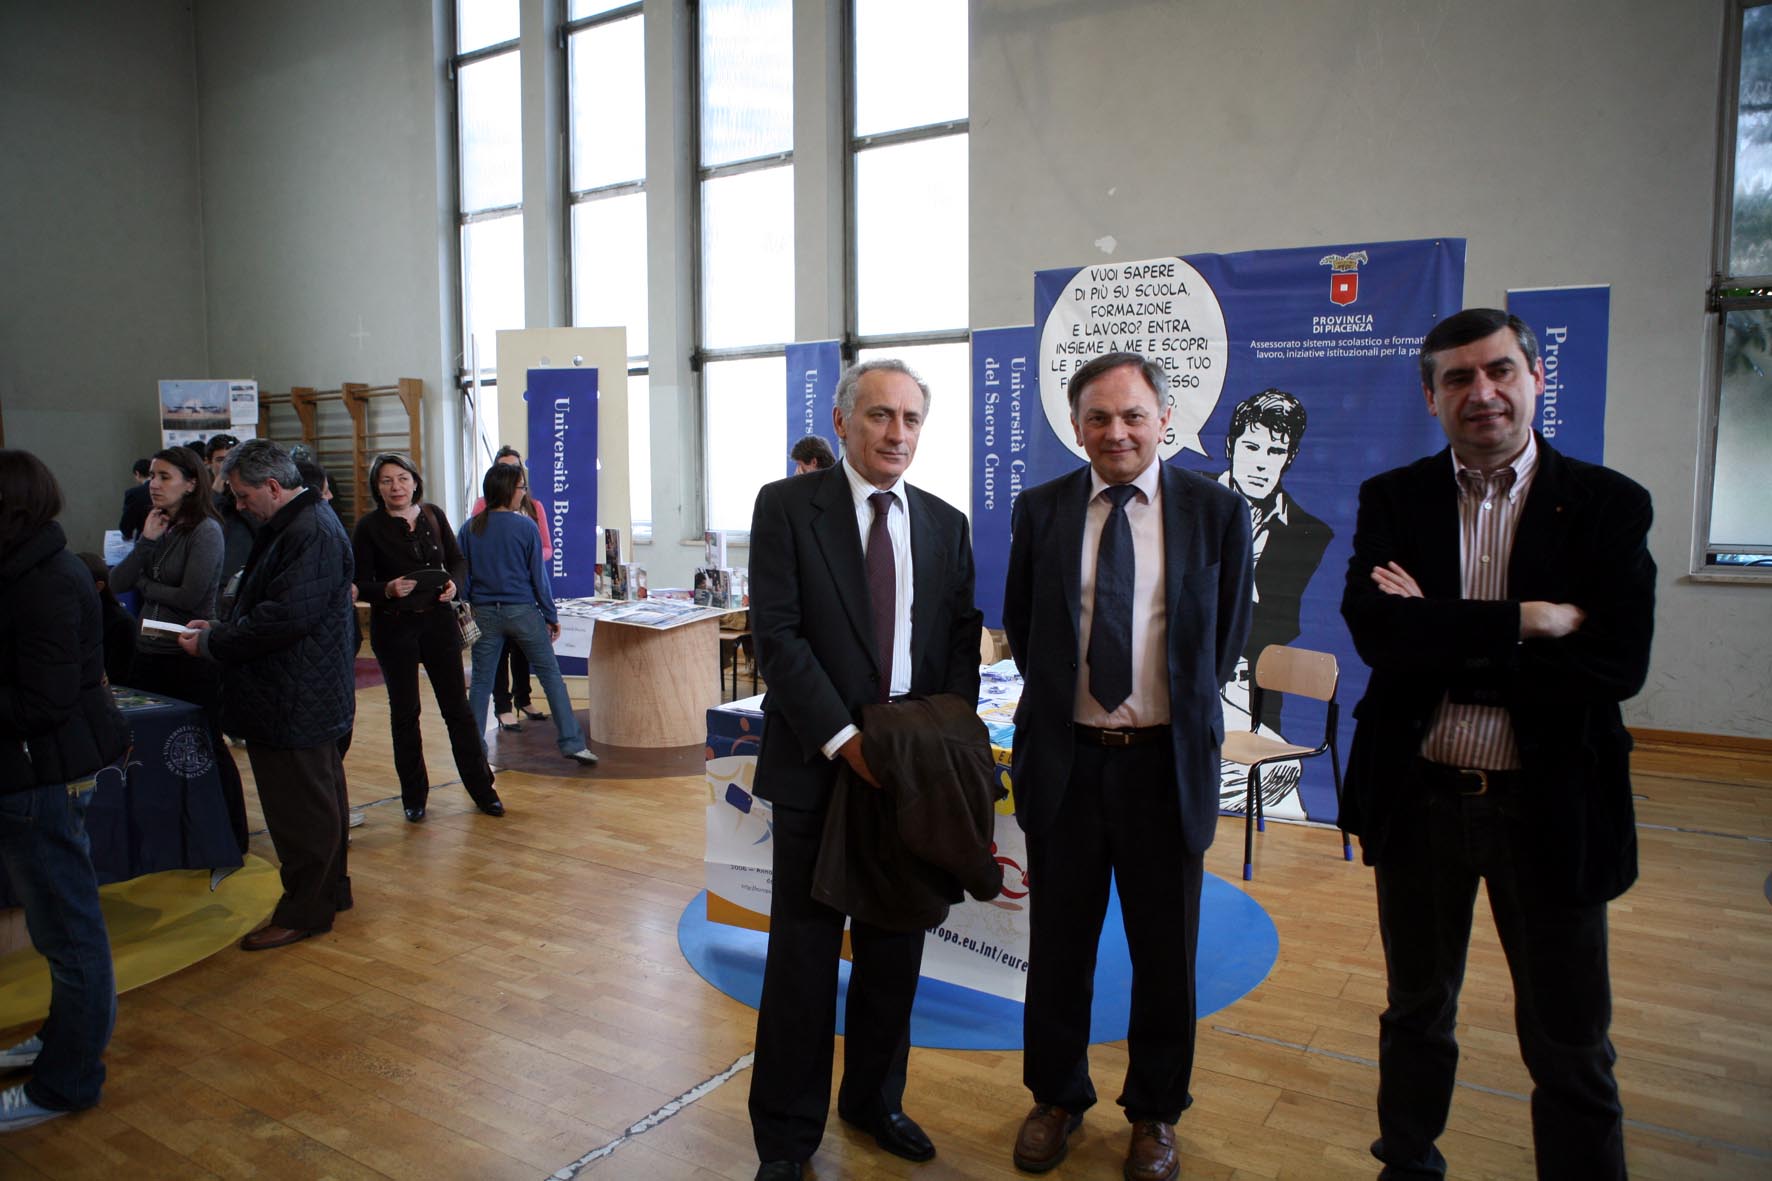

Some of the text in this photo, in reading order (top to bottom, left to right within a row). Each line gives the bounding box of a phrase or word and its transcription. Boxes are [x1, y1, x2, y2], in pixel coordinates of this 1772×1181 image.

[1090, 263, 1175, 282] VUOI SAPERE
[1075, 282, 1191, 301] DI PIÙ SU SCUOLA,
[1090, 301, 1172, 318] FORMAZIONE
[1072, 319, 1191, 337] E LAVORO? ENTRA
[1313, 314, 1374, 325] PROVINCIA
[1313, 323, 1373, 334] DI PIACENZA
[1056, 338, 1208, 354] INSIEME A ME E SCOPRI
[1250, 340, 1301, 349] Assessorato
[1302, 338, 1336, 348] sistema
[1338, 337, 1383, 347] scolastico
[1256, 349, 1286, 360] lavoro,
[1287, 348, 1325, 358] iniziative
[1327, 346, 1379, 358] istituzionali
[1380, 347, 1397, 358] per
[1398, 346, 1407, 355] la
[1051, 359, 1067, 373] LE
[1155, 357, 1180, 370] DEL
[1186, 356, 1212, 370] TUO
[1542, 326, 1568, 439] Provincia
[1010, 356, 1026, 453] Università
[984, 357, 1000, 511] del Sacro Cuore
[553, 397, 570, 577] Università Bocconi
